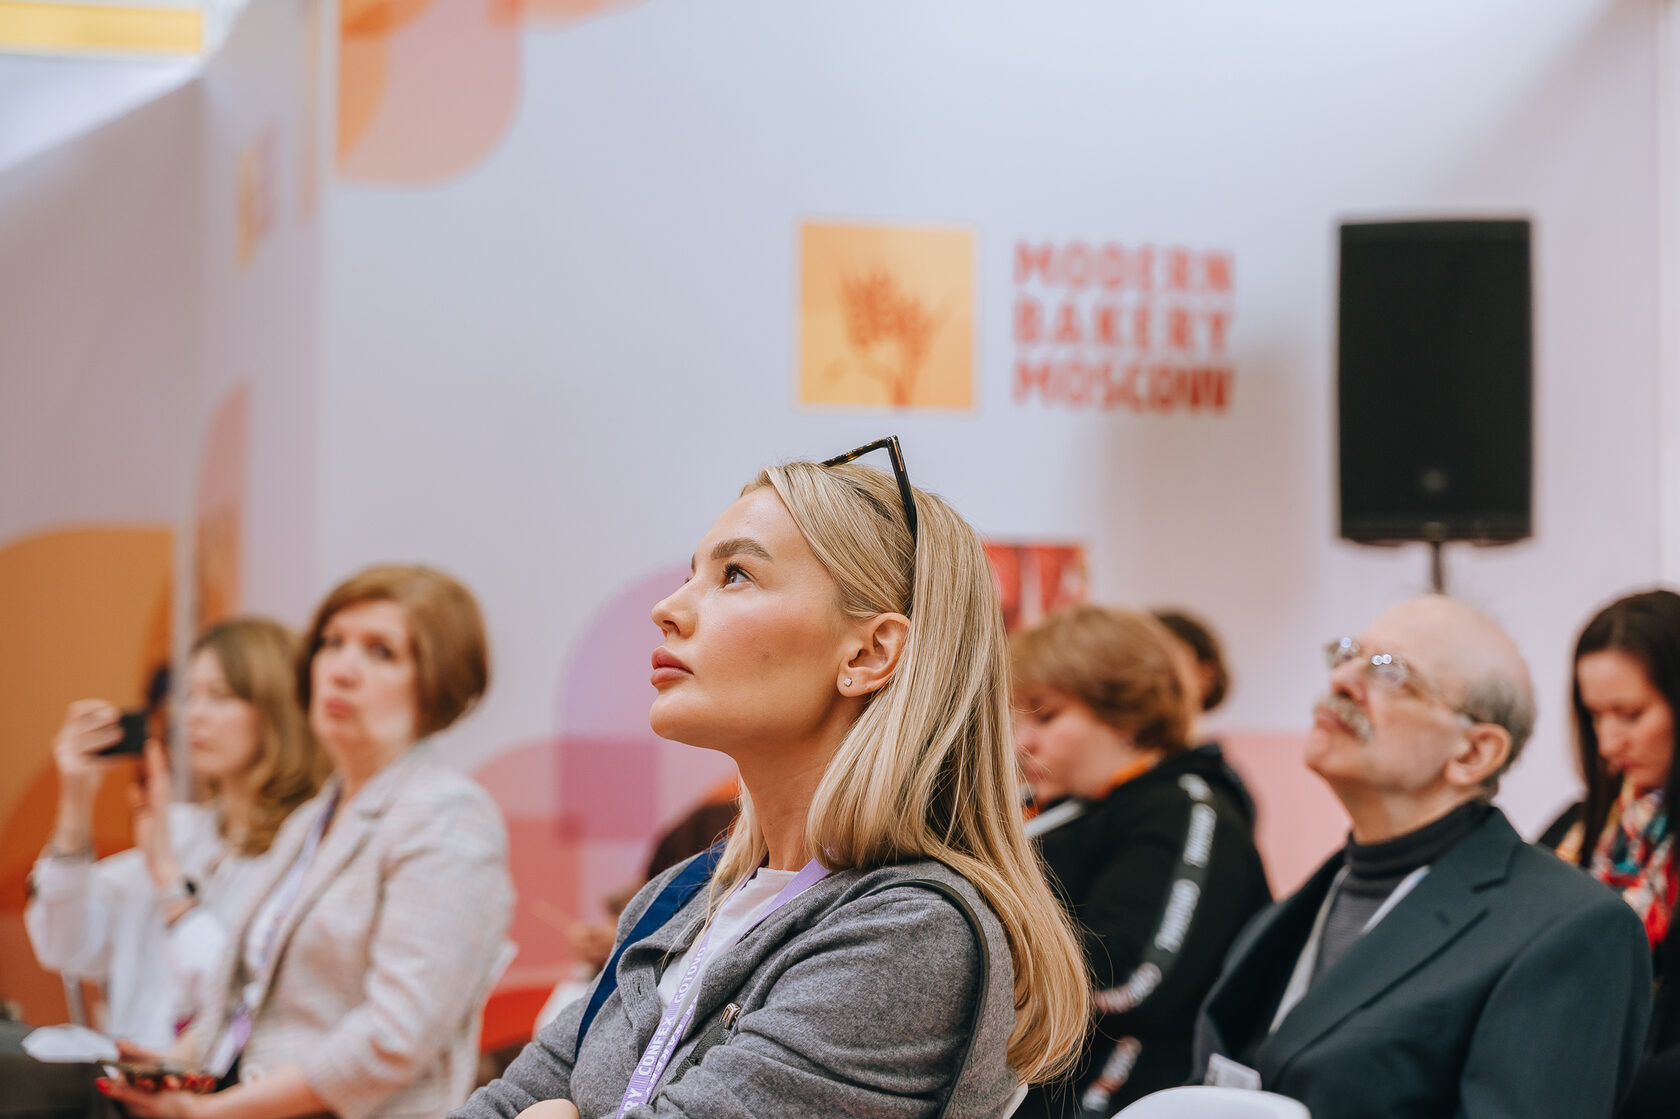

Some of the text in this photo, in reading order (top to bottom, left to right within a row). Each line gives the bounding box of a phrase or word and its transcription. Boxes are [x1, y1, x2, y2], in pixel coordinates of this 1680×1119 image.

[1013, 241, 1234, 292] MODERN
[1013, 297, 1234, 352] BAKERY
[1013, 360, 1235, 414] MOSCOW
[638, 1016, 674, 1076] CONFEX
